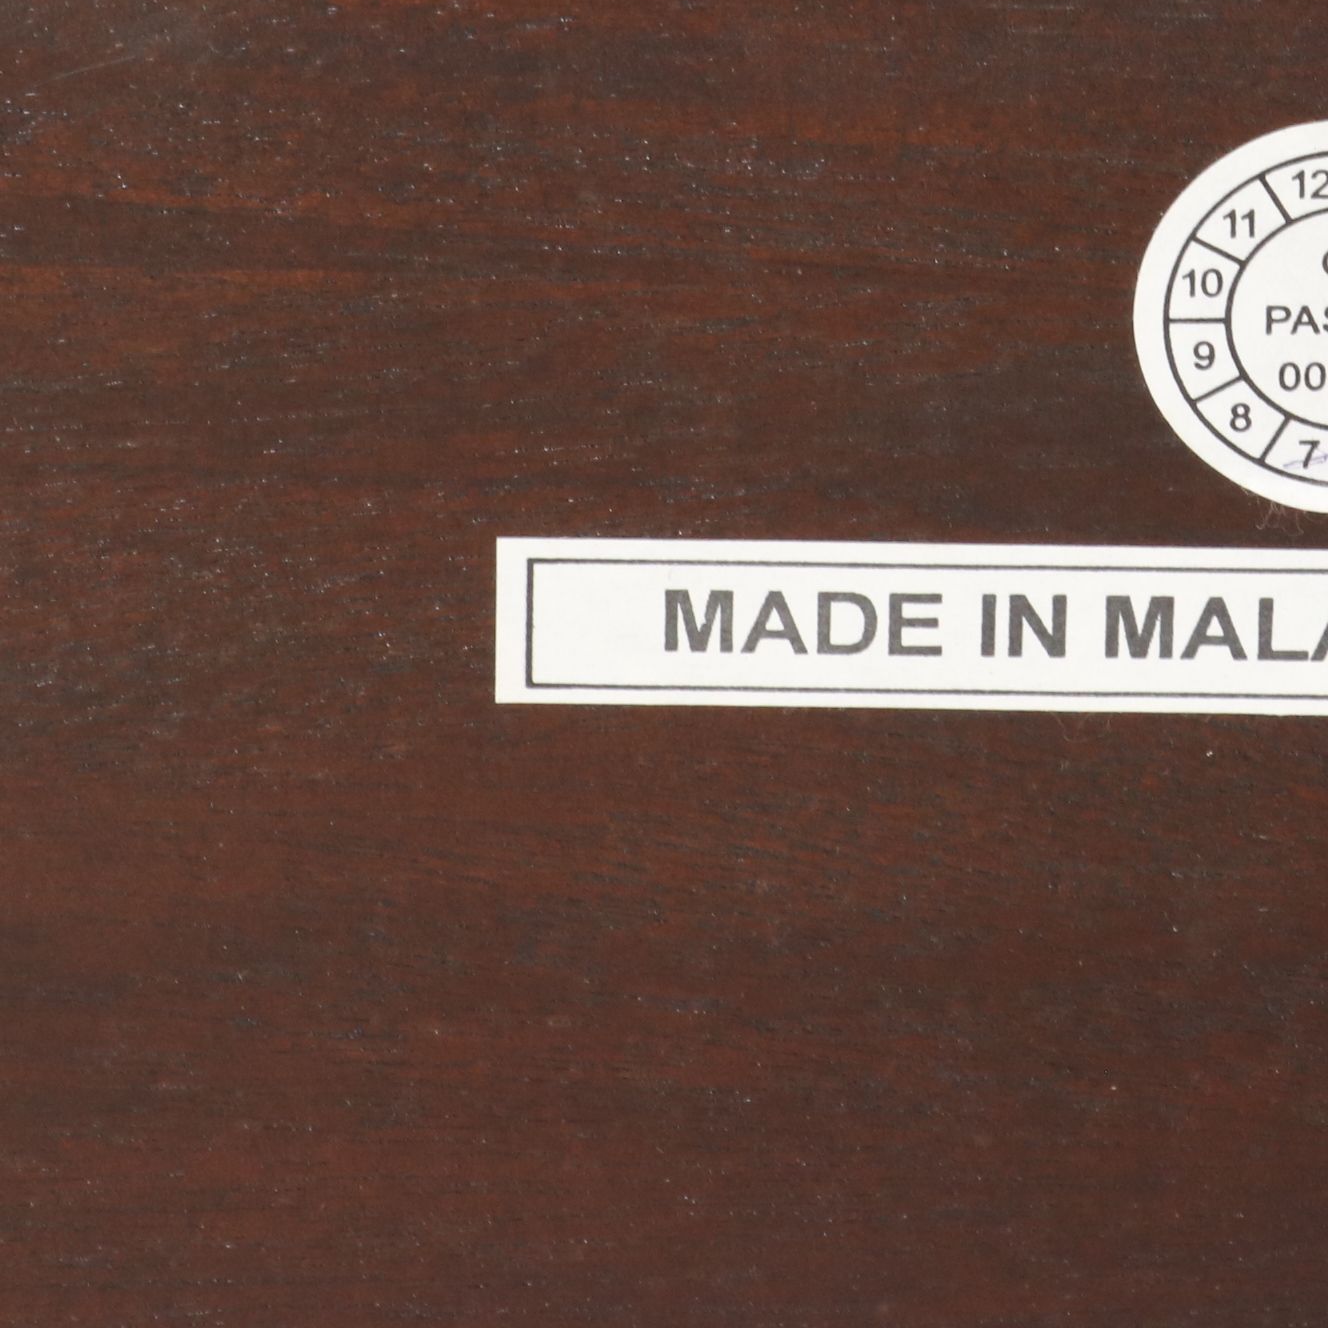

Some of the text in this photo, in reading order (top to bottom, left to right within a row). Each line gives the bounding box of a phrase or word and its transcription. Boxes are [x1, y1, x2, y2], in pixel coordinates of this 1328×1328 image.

[1223, 208, 1256, 239] 11
[1181, 268, 1224, 298] 10
[1193, 341, 1216, 370] 9
[1230, 402, 1252, 432] 8
[1298, 440, 1321, 469] 7
[662, 588, 943, 657] MADE
[981, 593, 1068, 660] IN
